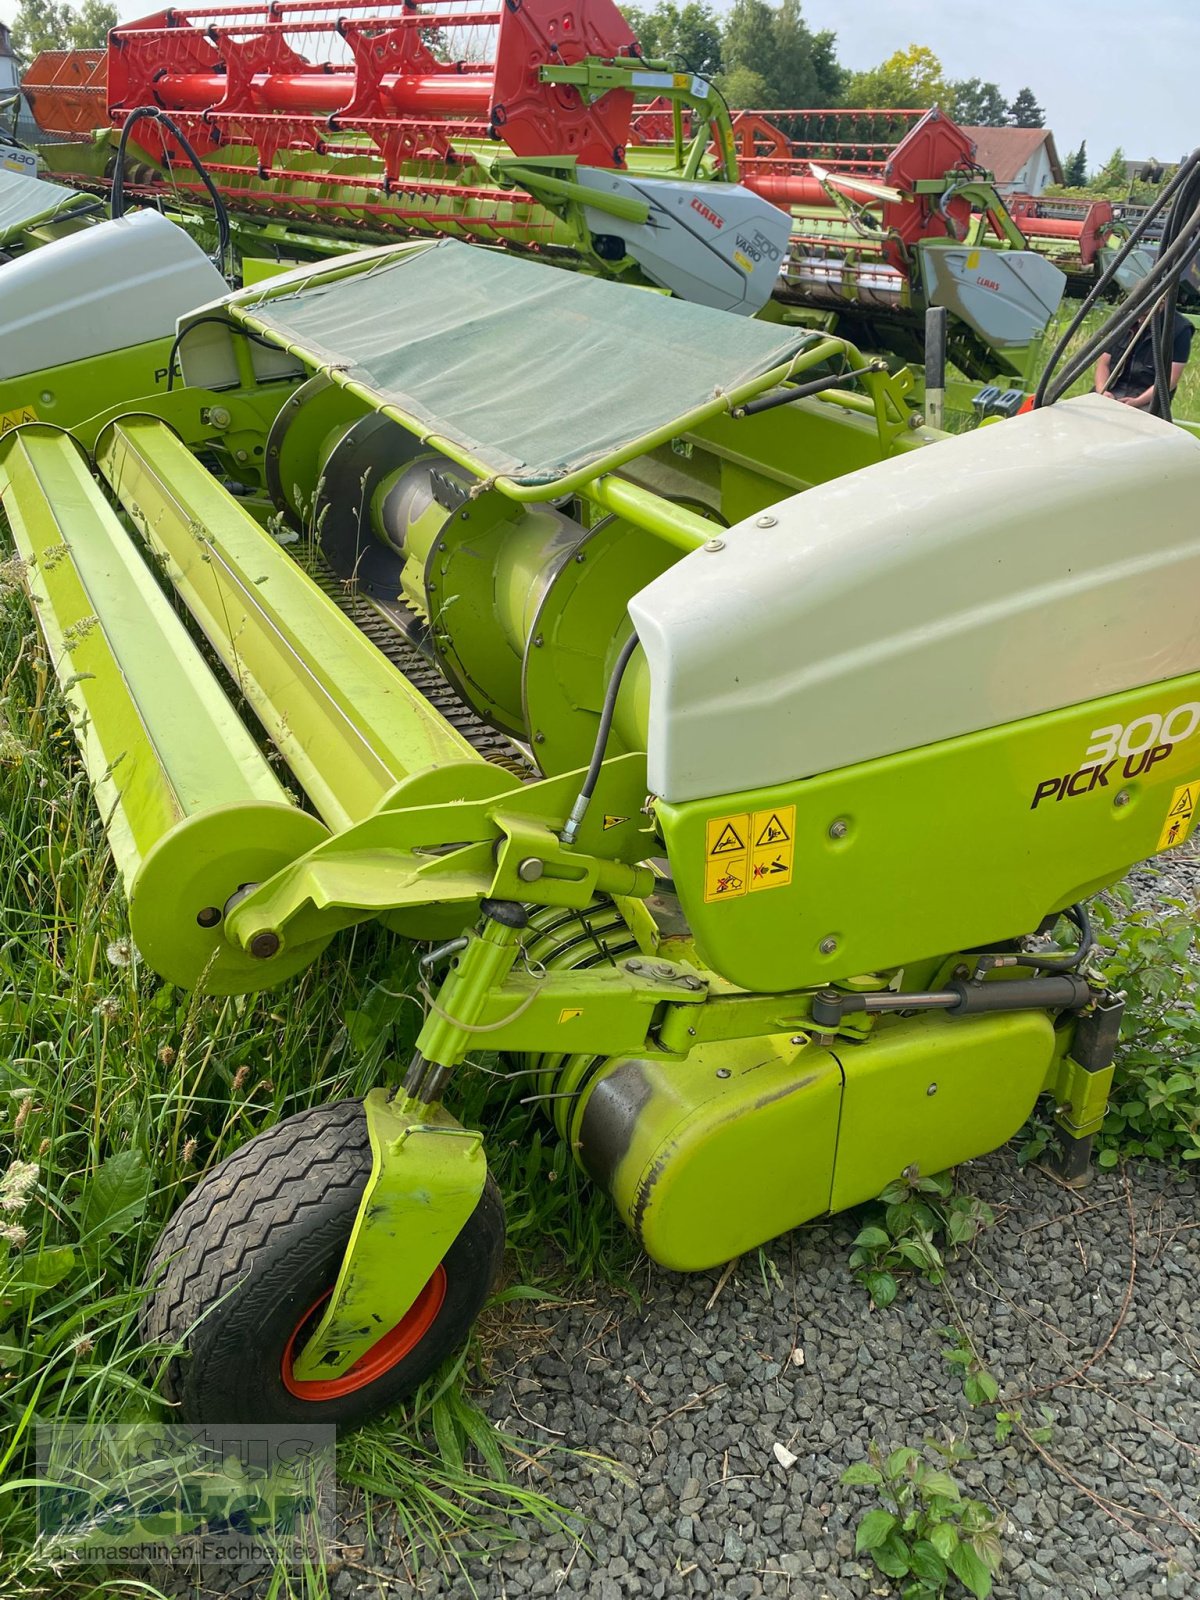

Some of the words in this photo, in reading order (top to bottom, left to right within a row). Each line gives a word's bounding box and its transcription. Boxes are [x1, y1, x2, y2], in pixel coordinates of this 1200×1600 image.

[8, 153, 35, 165] 430
[690, 198, 724, 229] CLAAS
[735, 236, 762, 262] VARIO
[751, 231, 779, 262] 500
[976, 276, 1000, 291] CLAAS
[1079, 701, 1200, 771] 300
[1030, 759, 1118, 810] PICK
[1122, 743, 1173, 779] UP
